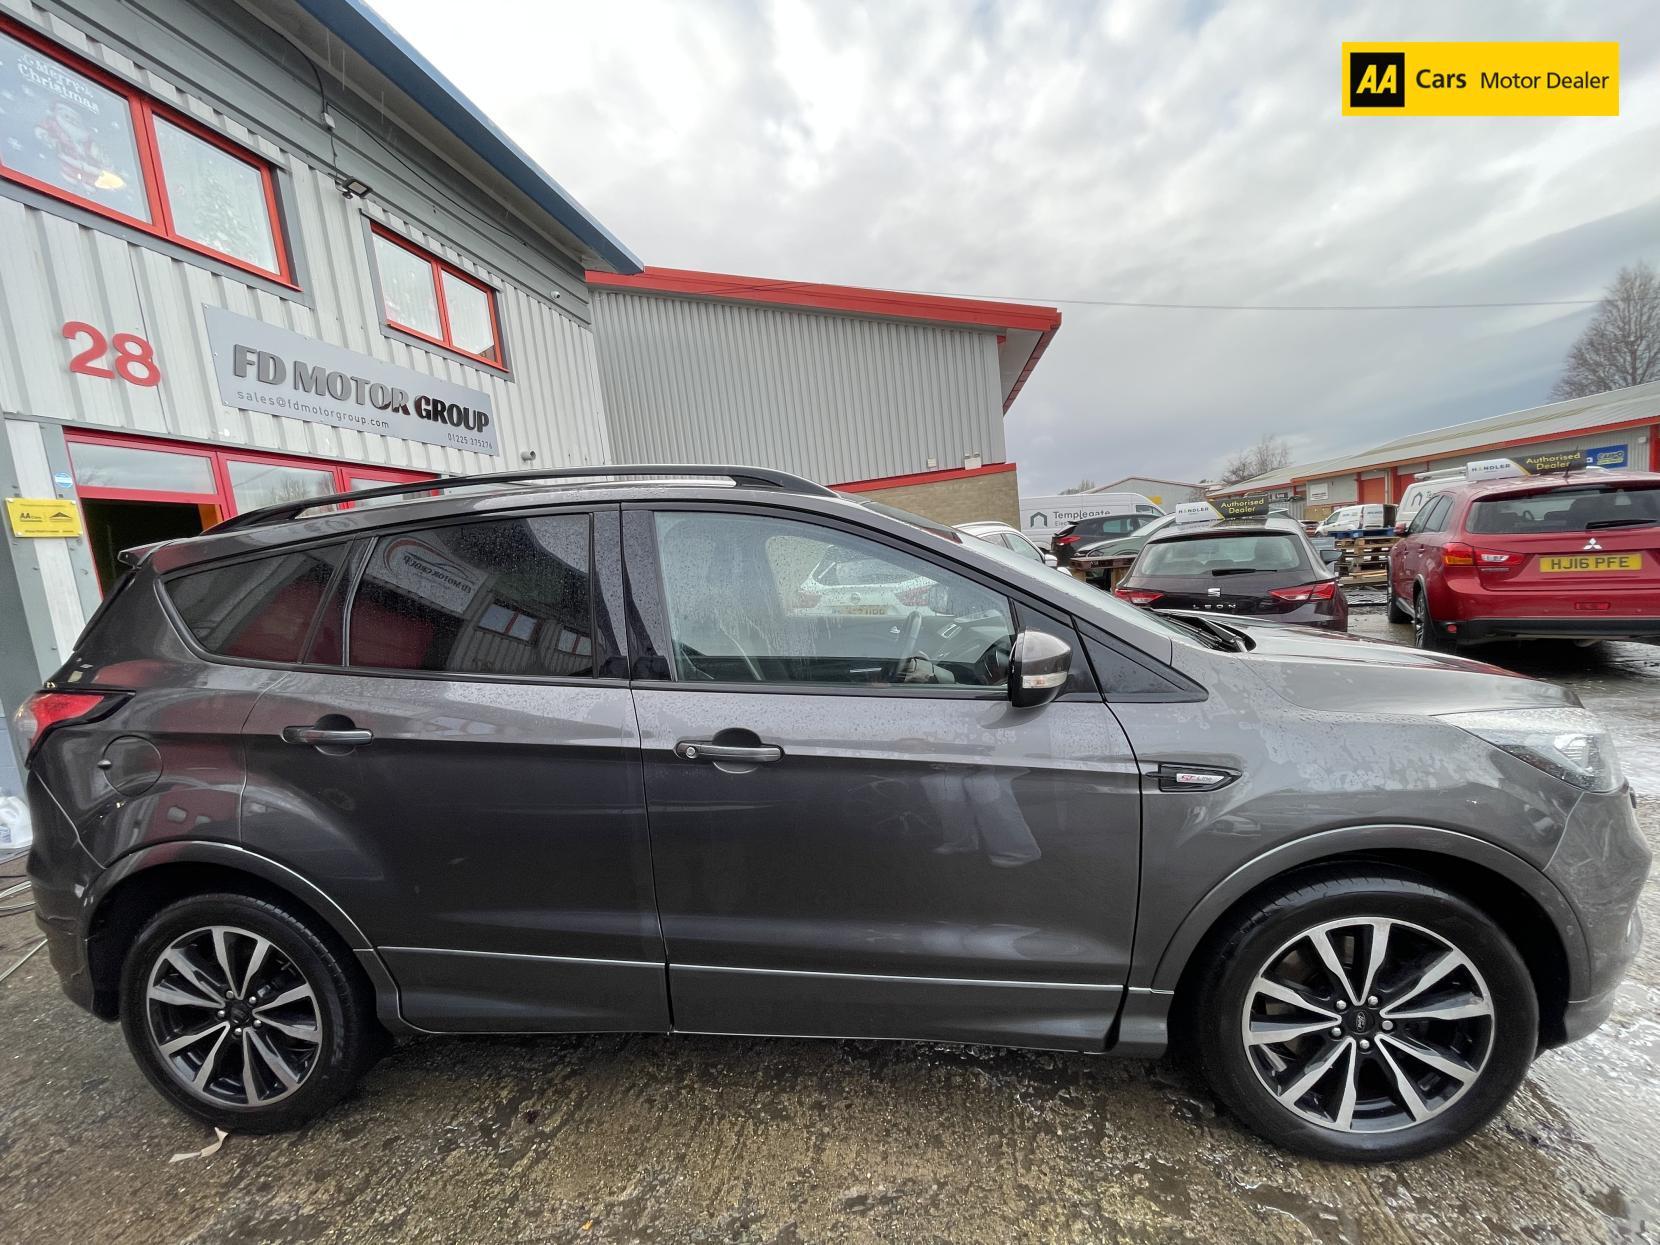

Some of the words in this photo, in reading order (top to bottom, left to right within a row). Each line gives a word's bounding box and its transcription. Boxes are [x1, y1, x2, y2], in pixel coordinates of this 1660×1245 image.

[18, 62, 100, 113] Christmas
[61, 321, 161, 387] 28
[233, 343, 287, 385] FD
[293, 360, 410, 416] MOTOR
[414, 394, 490, 433] GROUP
[237, 389, 391, 429] sales@fdmotorgroup.com
[447, 432, 468, 444] 01225
[1525, 452, 1581, 465] Authorised
[1536, 461, 1571, 471] Dealer
[1220, 498, 1265, 508] Authorised
[1228, 506, 1256, 514] Dealer
[1551, 558, 1588, 570] HJ16
[1595, 556, 1630, 568] PFE
